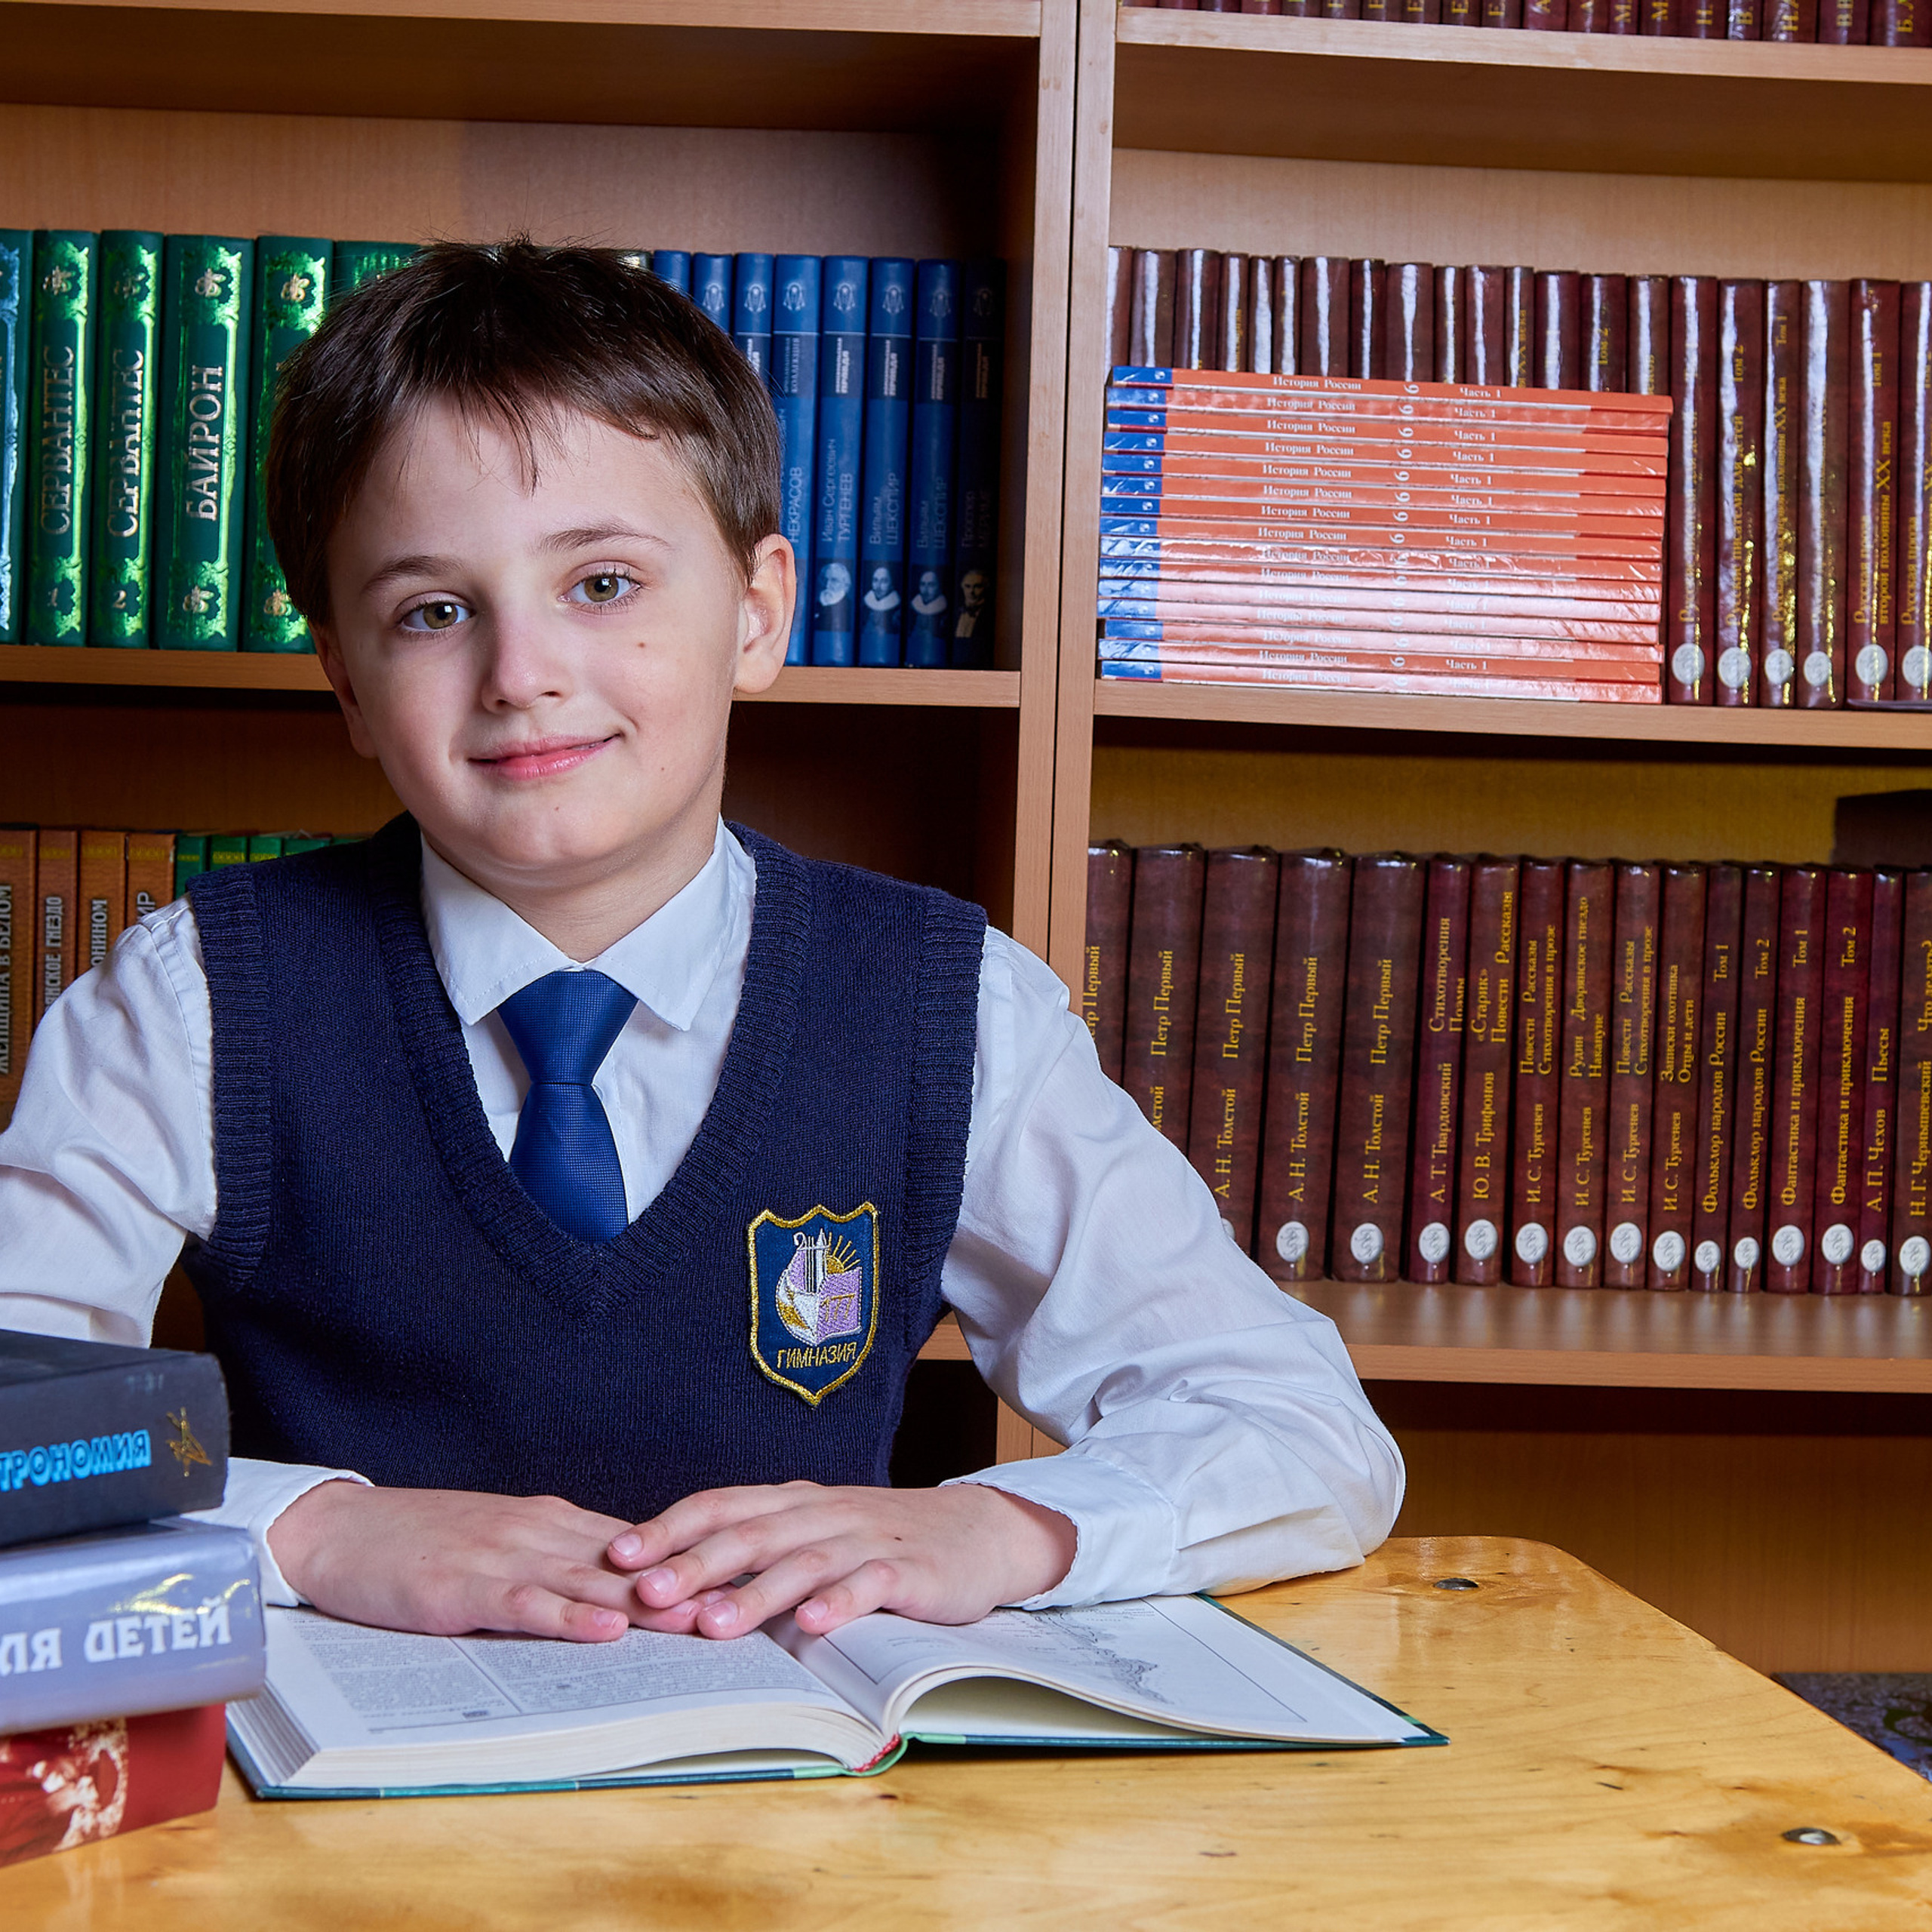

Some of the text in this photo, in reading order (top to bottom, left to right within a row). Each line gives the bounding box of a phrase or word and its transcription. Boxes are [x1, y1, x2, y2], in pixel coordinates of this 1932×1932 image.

[1273, 377, 1319, 389] История
[1324, 379, 1361, 389] России
[1404, 384, 1419, 395] 6
[1460, 387, 1491, 398] Часть
[41, 346, 74, 535] СЕРВАНТЕС
[106, 349, 145, 537] СЕРВАНТЕС
[184, 365, 223, 521] БАЙРОН
[1263, 465, 1309, 477] История
[1314, 467, 1351, 477] России
[1394, 471, 1410, 481] 6
[1451, 474, 1481, 485] Часть
[1882, 422, 1890, 454] века
[788, 466, 803, 543] НЕКРАСОВ
[838, 472, 853, 543] ТУРГЕНЕВ
[869, 496, 882, 544] Вильям
[884, 472, 900, 545] ШЕКСПИР
[1258, 528, 1304, 540] История
[1309, 530, 1346, 540] России
[1389, 534, 1405, 544] 6
[1446, 536, 1477, 546] Часть
[112, 589, 127, 610] 2
[1259, 651, 1304, 663] История
[1310, 653, 1348, 663] России
[1390, 657, 1405, 667] 6
[1446, 659, 1477, 670] Часть
[45, 897, 63, 948] ГНЕЗДО
[1546, 925, 1557, 961] прозе
[1793, 941, 1807, 967] Том
[1841, 940, 1855, 966] Том
[1151, 951, 1174, 1056] Петр Первый
[1429, 918, 1452, 1032] Стихотворения
[1450, 977, 1465, 1032] Поэмы
[1471, 969, 1491, 1041] «Старик»
[1491, 891, 1512, 1042] Повести Рассказы
[1569, 897, 1588, 1077] Рудин Дворянское гнездо
[1635, 977, 1651, 1075] Стихотворения
[1643, 926, 1654, 961] прозе
[1714, 955, 1727, 982] Том
[1520, 940, 1537, 1073] Повести Рассказы
[1538, 977, 1555, 1075] Стихотворения
[1589, 1014, 1605, 1077] Накануне
[1616, 942, 1634, 1073] Повести Рассказы
[1660, 965, 1678, 1081] Записки охотника
[1684, 1000, 1694, 1029] дети
[1709, 1013, 1726, 1066] России
[1214, 954, 1245, 1198] А. Н. Толстой Петр Первый
[1289, 958, 1318, 1201] А. Н. Толстой Петр Первый
[1363, 960, 1393, 1203] А. Н. Толстой Петр Первый
[1678, 1044, 1694, 1082] Отцы
[1743, 939, 1769, 1209] Фольклор народов России Том 2
[1792, 998, 1805, 1097] приключения
[1841, 997, 1854, 1095] приключения
[1430, 1063, 1451, 1202] А. Т. Твардовский
[1473, 1072, 1495, 1198] Ю. В. Трифонов
[1712, 1071, 1724, 1131] народов
[1791, 1101, 1800, 1109] и
[1841, 1100, 1849, 1109] и
[1867, 1029, 1889, 1211] А. П. Чехов Пьесы
[1912, 1061, 1931, 1174] Чернышевский
[1527, 1104, 1544, 1201] И. С. Тургенев
[1576, 1107, 1593, 1204] И. С. Тургенев
[1622, 1104, 1640, 1201] И. С. Тургенев
[1664, 1112, 1681, 1210] И. С. Тургенев
[1702, 1135, 1723, 1213] Фольклор
[1781, 1115, 1799, 1205] Фантастика
[1831, 1114, 1848, 1204] Фантастика
[1911, 1180, 1926, 1191] Г.
[1910, 1196, 1925, 1215] Н.
[777, 1341, 857, 1370] ГИМНАЗИЯ
[84, 1596, 232, 1663] ДЕТЕЙ
